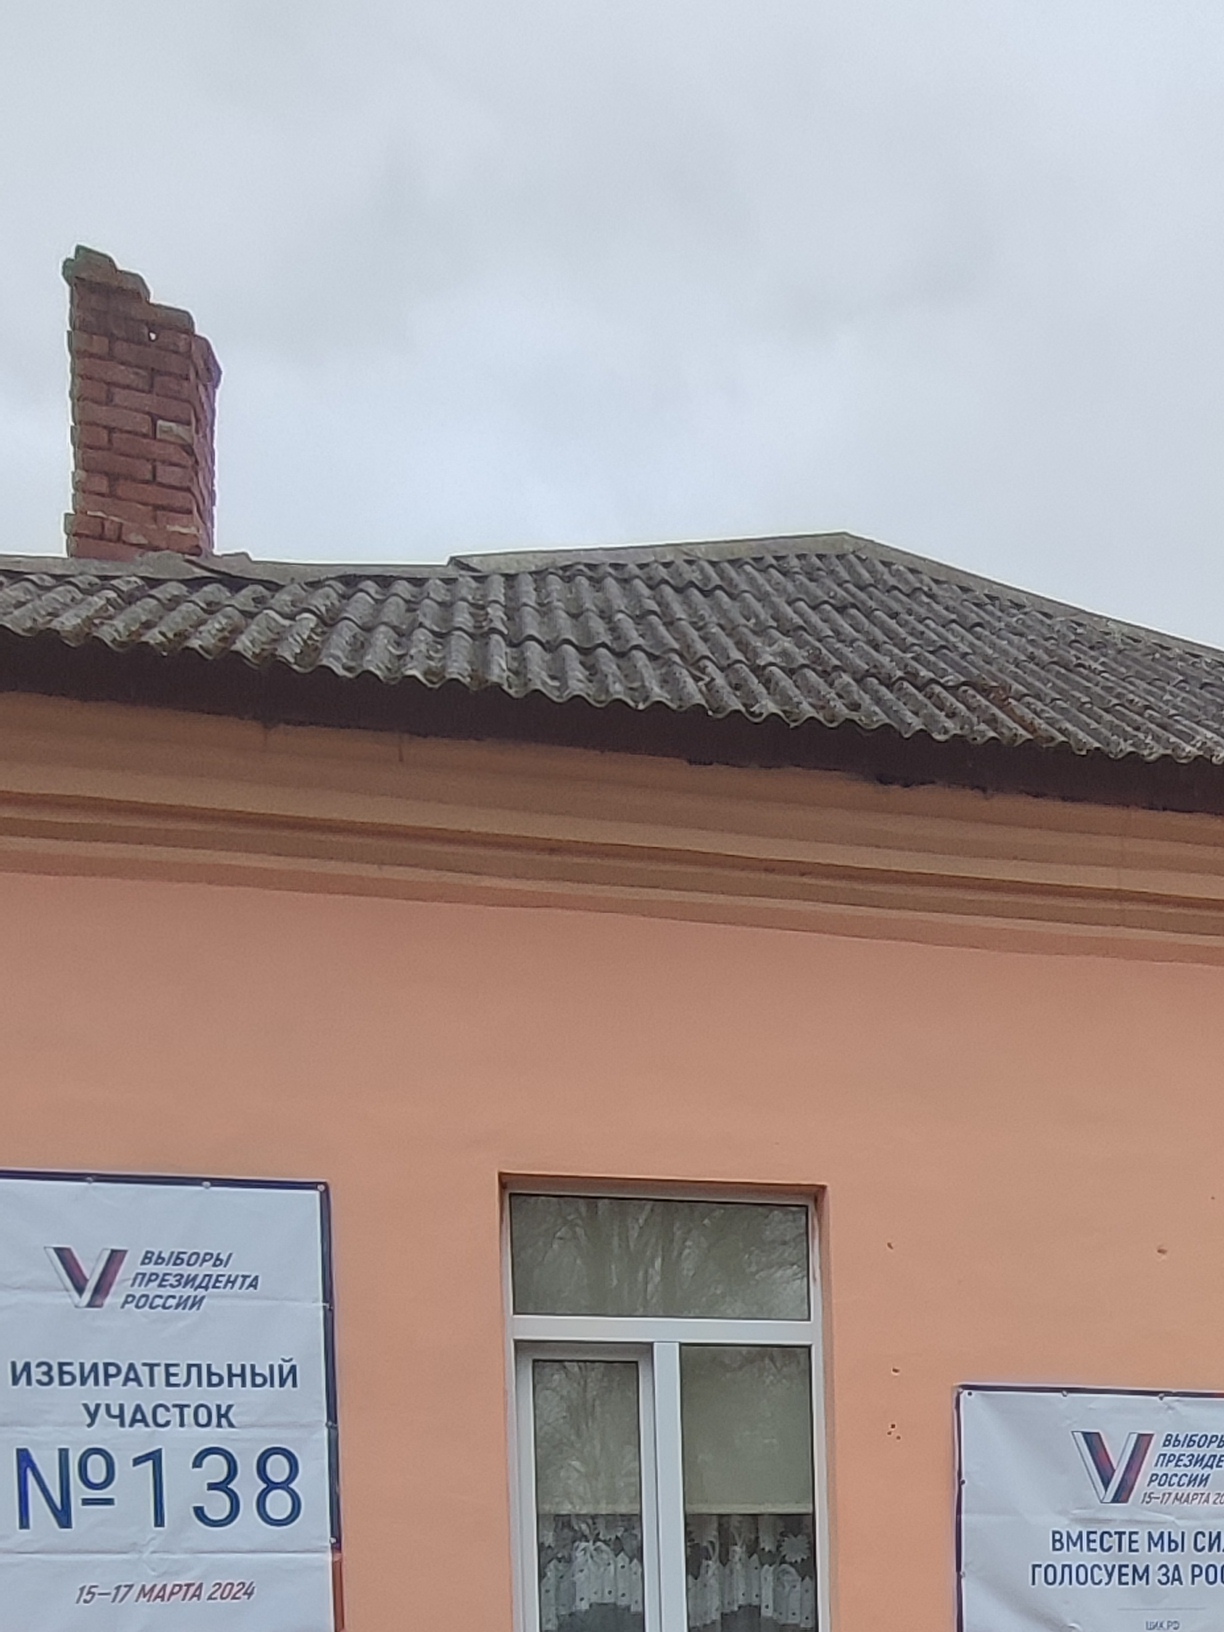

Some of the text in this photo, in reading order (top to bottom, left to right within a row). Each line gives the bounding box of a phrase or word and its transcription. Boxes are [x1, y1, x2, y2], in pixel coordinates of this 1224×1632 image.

[139, 1249, 233, 1268] ВЫБОРЫ
[130, 1272, 260, 1292] ПРЕЗИДЕНТА
[120, 1293, 206, 1312] РОССИИ
[10, 1358, 299, 1390] ИЗБИРАТЕЛЬНЫЙ
[82, 1402, 236, 1429] УЧАСТОК
[1147, 1473, 1211, 1488] РОССИИ
[1172, 1491, 1211, 1506] МАРТА
[1050, 1530, 1140, 1553] ВМЕСТЕ
[1146, 1530, 1185, 1554] МЫ
[1030, 1563, 1151, 1586] ГОЛОСУЕМ
[1156, 1564, 1184, 1586] ЗА
[135, 1583, 204, 1603] МАРТА
[207, 1581, 256, 1601] 2024
